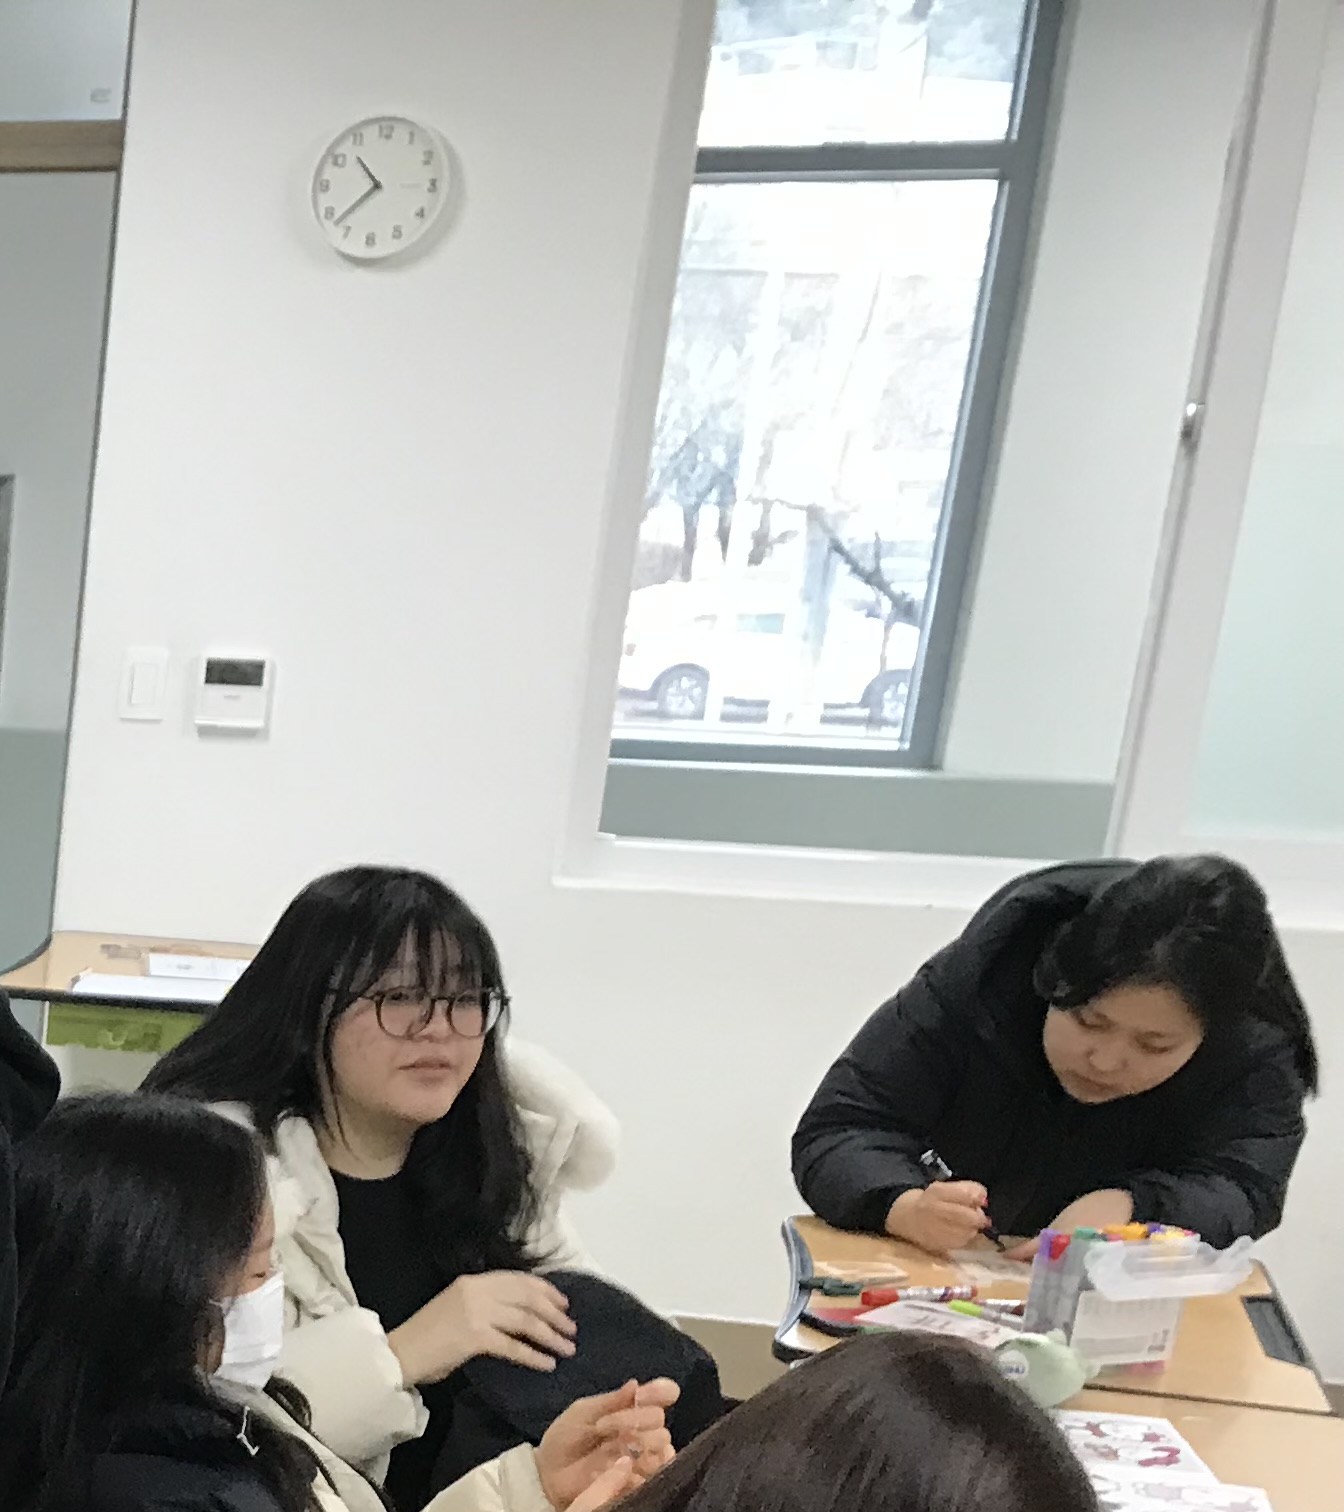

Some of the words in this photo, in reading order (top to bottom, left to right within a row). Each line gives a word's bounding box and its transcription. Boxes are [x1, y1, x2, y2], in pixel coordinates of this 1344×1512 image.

[352, 131, 364, 146] 11
[414, 206, 425, 219] 4
[342, 225, 352, 239] 7
